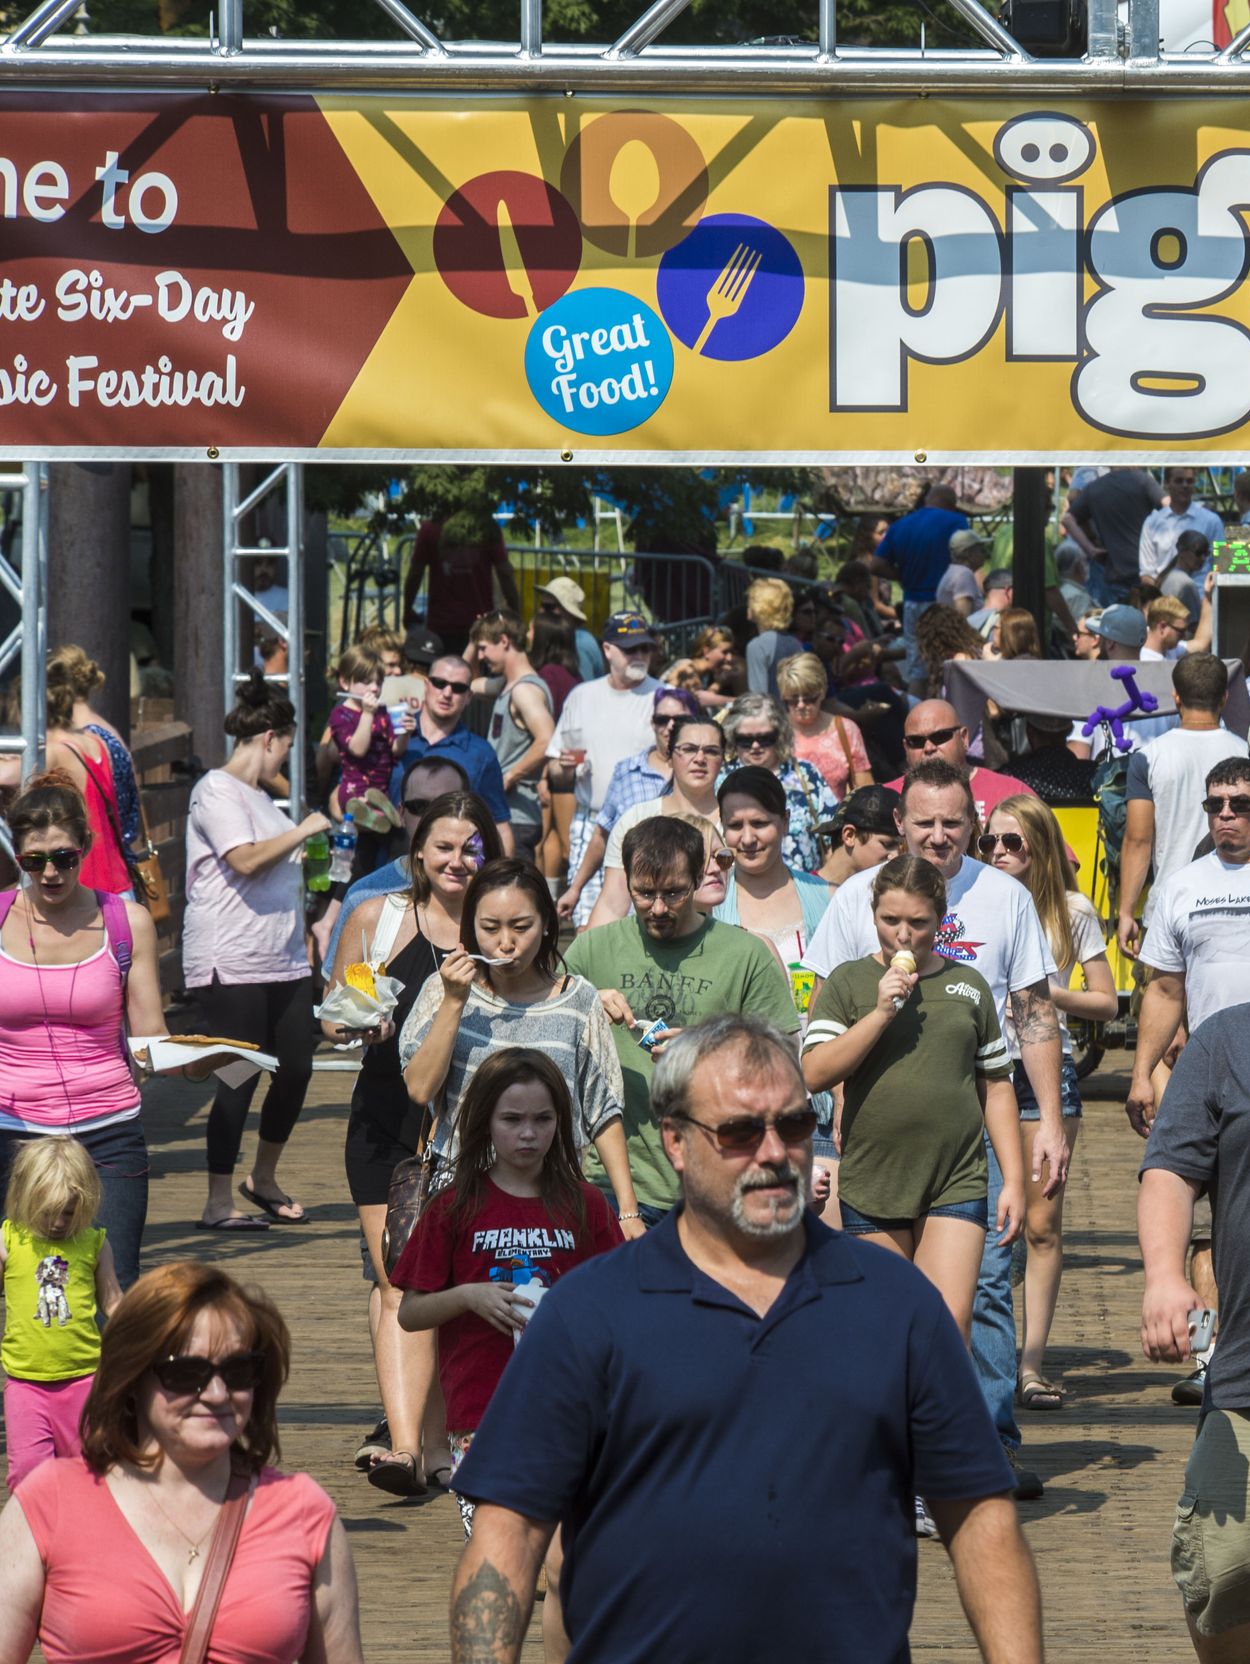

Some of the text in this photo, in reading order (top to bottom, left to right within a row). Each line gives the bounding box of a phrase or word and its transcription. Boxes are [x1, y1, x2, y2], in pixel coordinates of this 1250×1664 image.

[95, 151, 178, 234] to
[55, 269, 255, 342] Six-Day
[542, 313, 650, 373] Great
[66, 354, 246, 407] Festival
[551, 360, 659, 413] Food!
[620, 972, 713, 996] BANFF
[471, 1226, 576, 1253] FRANKLIN
